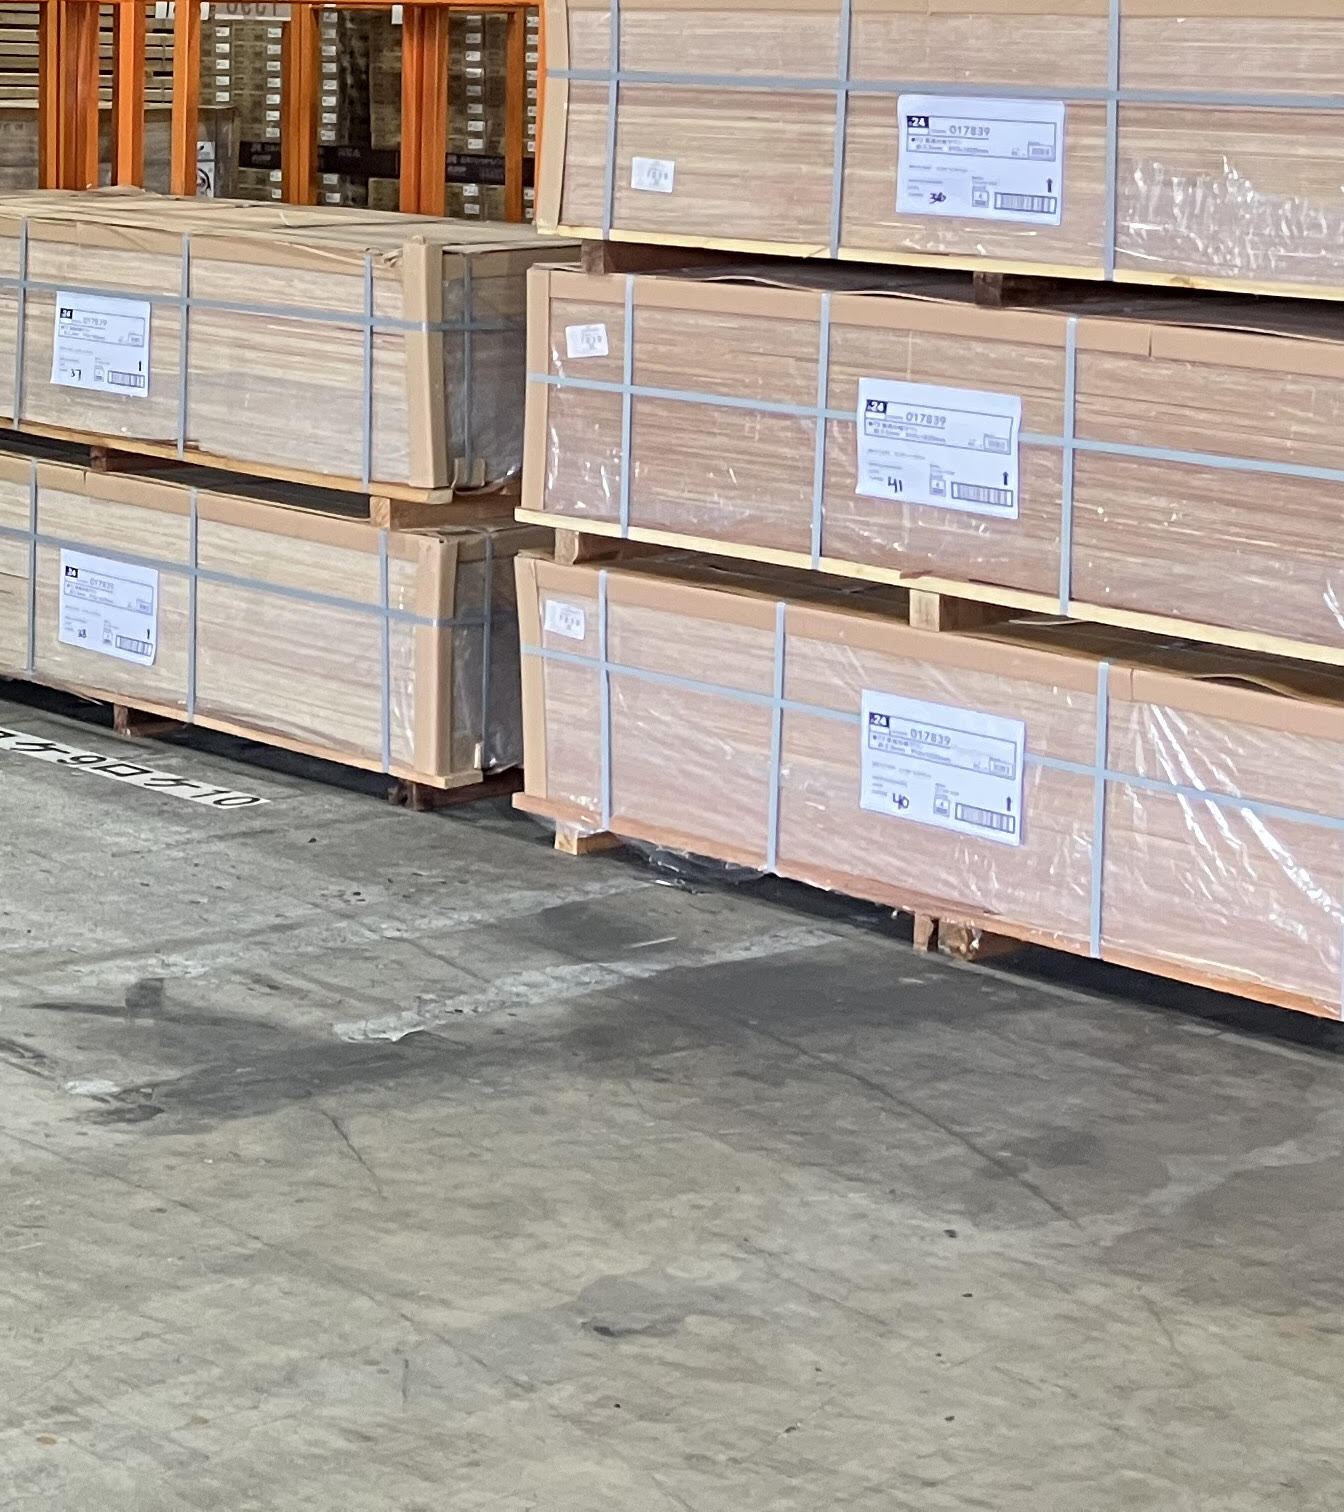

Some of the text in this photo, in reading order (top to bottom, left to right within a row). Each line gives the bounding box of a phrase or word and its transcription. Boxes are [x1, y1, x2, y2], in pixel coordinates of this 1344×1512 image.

[949, 124, 991, 137] 017839
[905, 411, 947, 427] 017839
[887, 476, 903, 494] 41
[909, 728, 952, 746] 017839
[892, 792, 910, 810] 40
